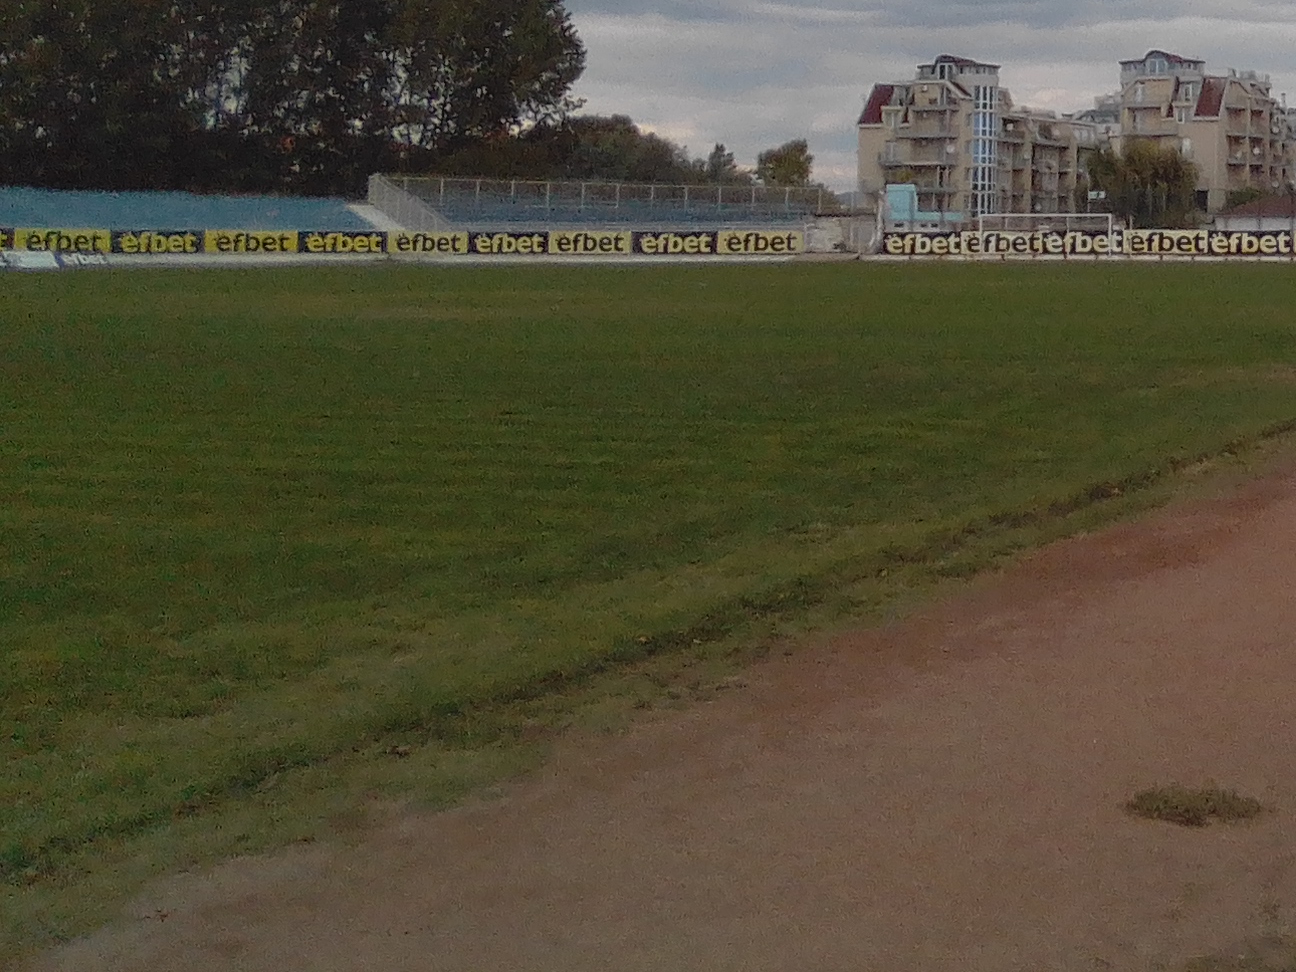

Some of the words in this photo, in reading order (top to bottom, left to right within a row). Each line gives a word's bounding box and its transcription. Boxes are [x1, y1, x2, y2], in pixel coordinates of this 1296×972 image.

[27, 230, 102, 251] efbet
[118, 231, 198, 253] efbet
[216, 232, 291, 252] efbet
[305, 232, 382, 253] efbet
[396, 232, 462, 252] efbet
[474, 233, 545, 253] efbet
[556, 233, 625, 252] efbet
[641, 233, 714, 254] efbet
[724, 233, 798, 252] efbet
[885, 231, 961, 255] efbet
[966, 233, 1042, 253] efbet
[1043, 231, 1122, 255] efbet
[1128, 232, 1206, 253] efbet
[1209, 232, 1291, 254] efbet
